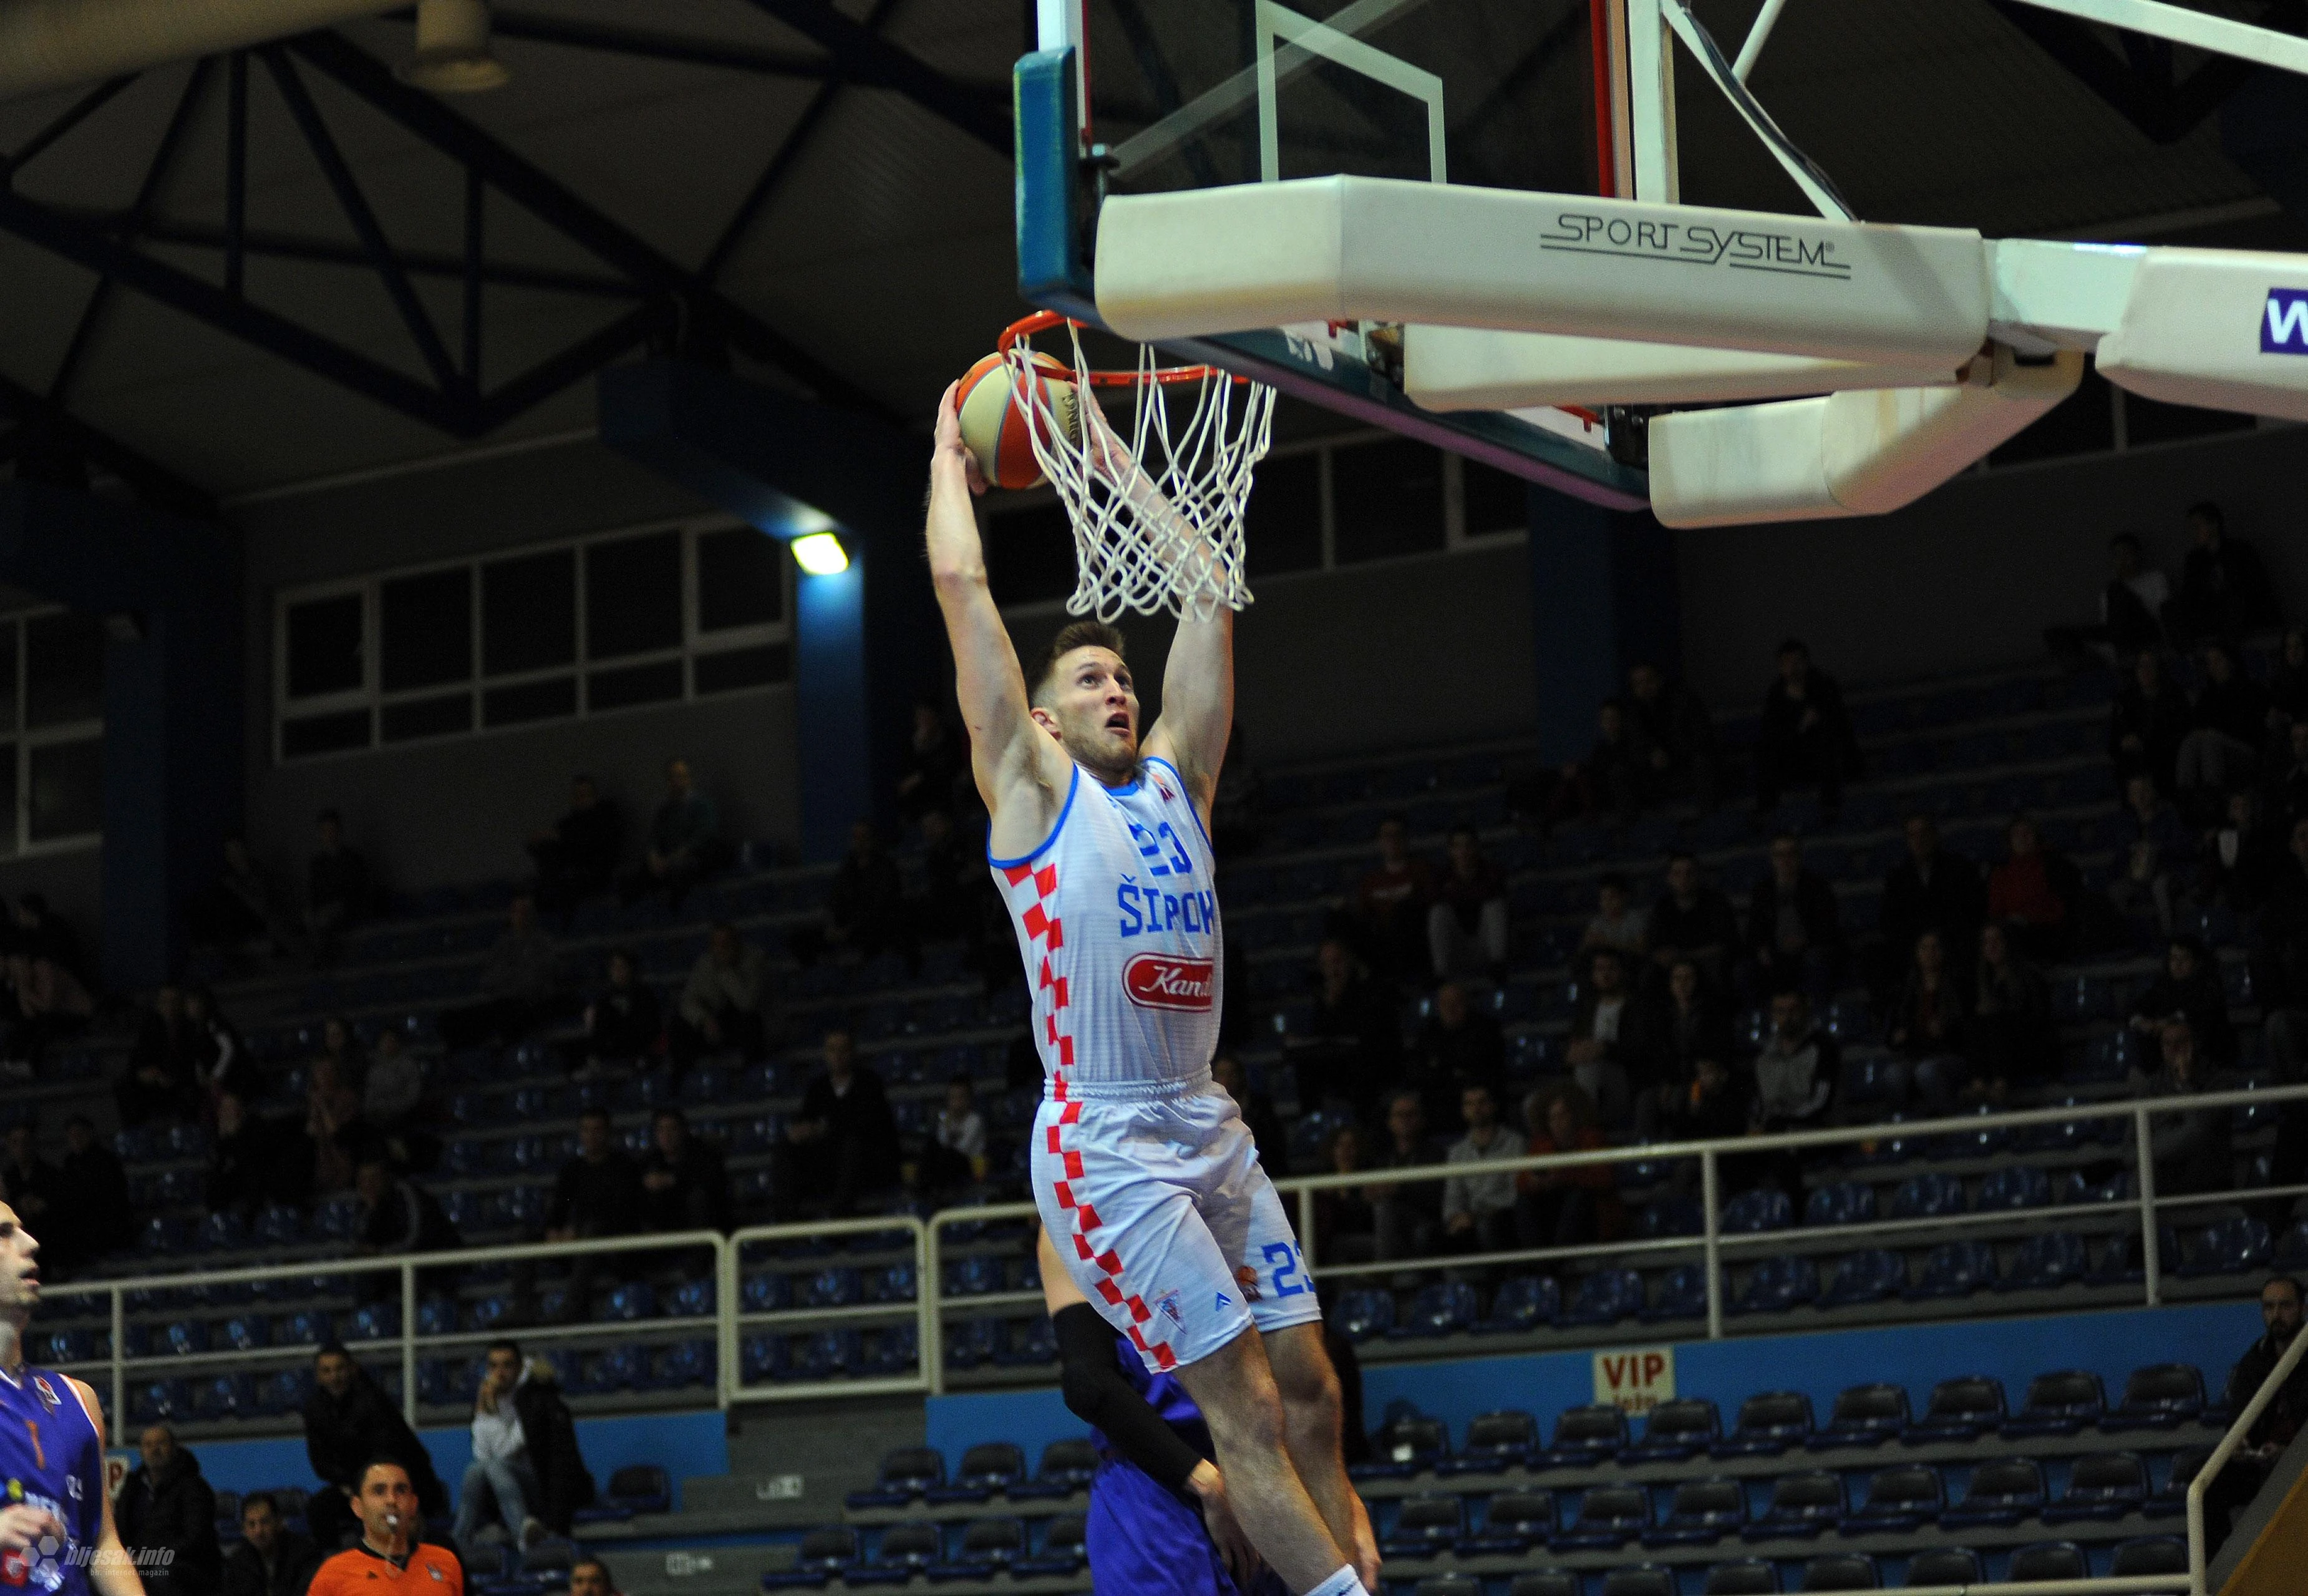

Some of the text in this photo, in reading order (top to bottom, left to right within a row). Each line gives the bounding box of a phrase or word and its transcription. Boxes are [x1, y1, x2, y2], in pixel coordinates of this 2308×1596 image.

[1541, 213, 1679, 249] SPORT
[1128, 821, 1192, 876] 23
[1603, 1352, 1664, 1390] VIP
